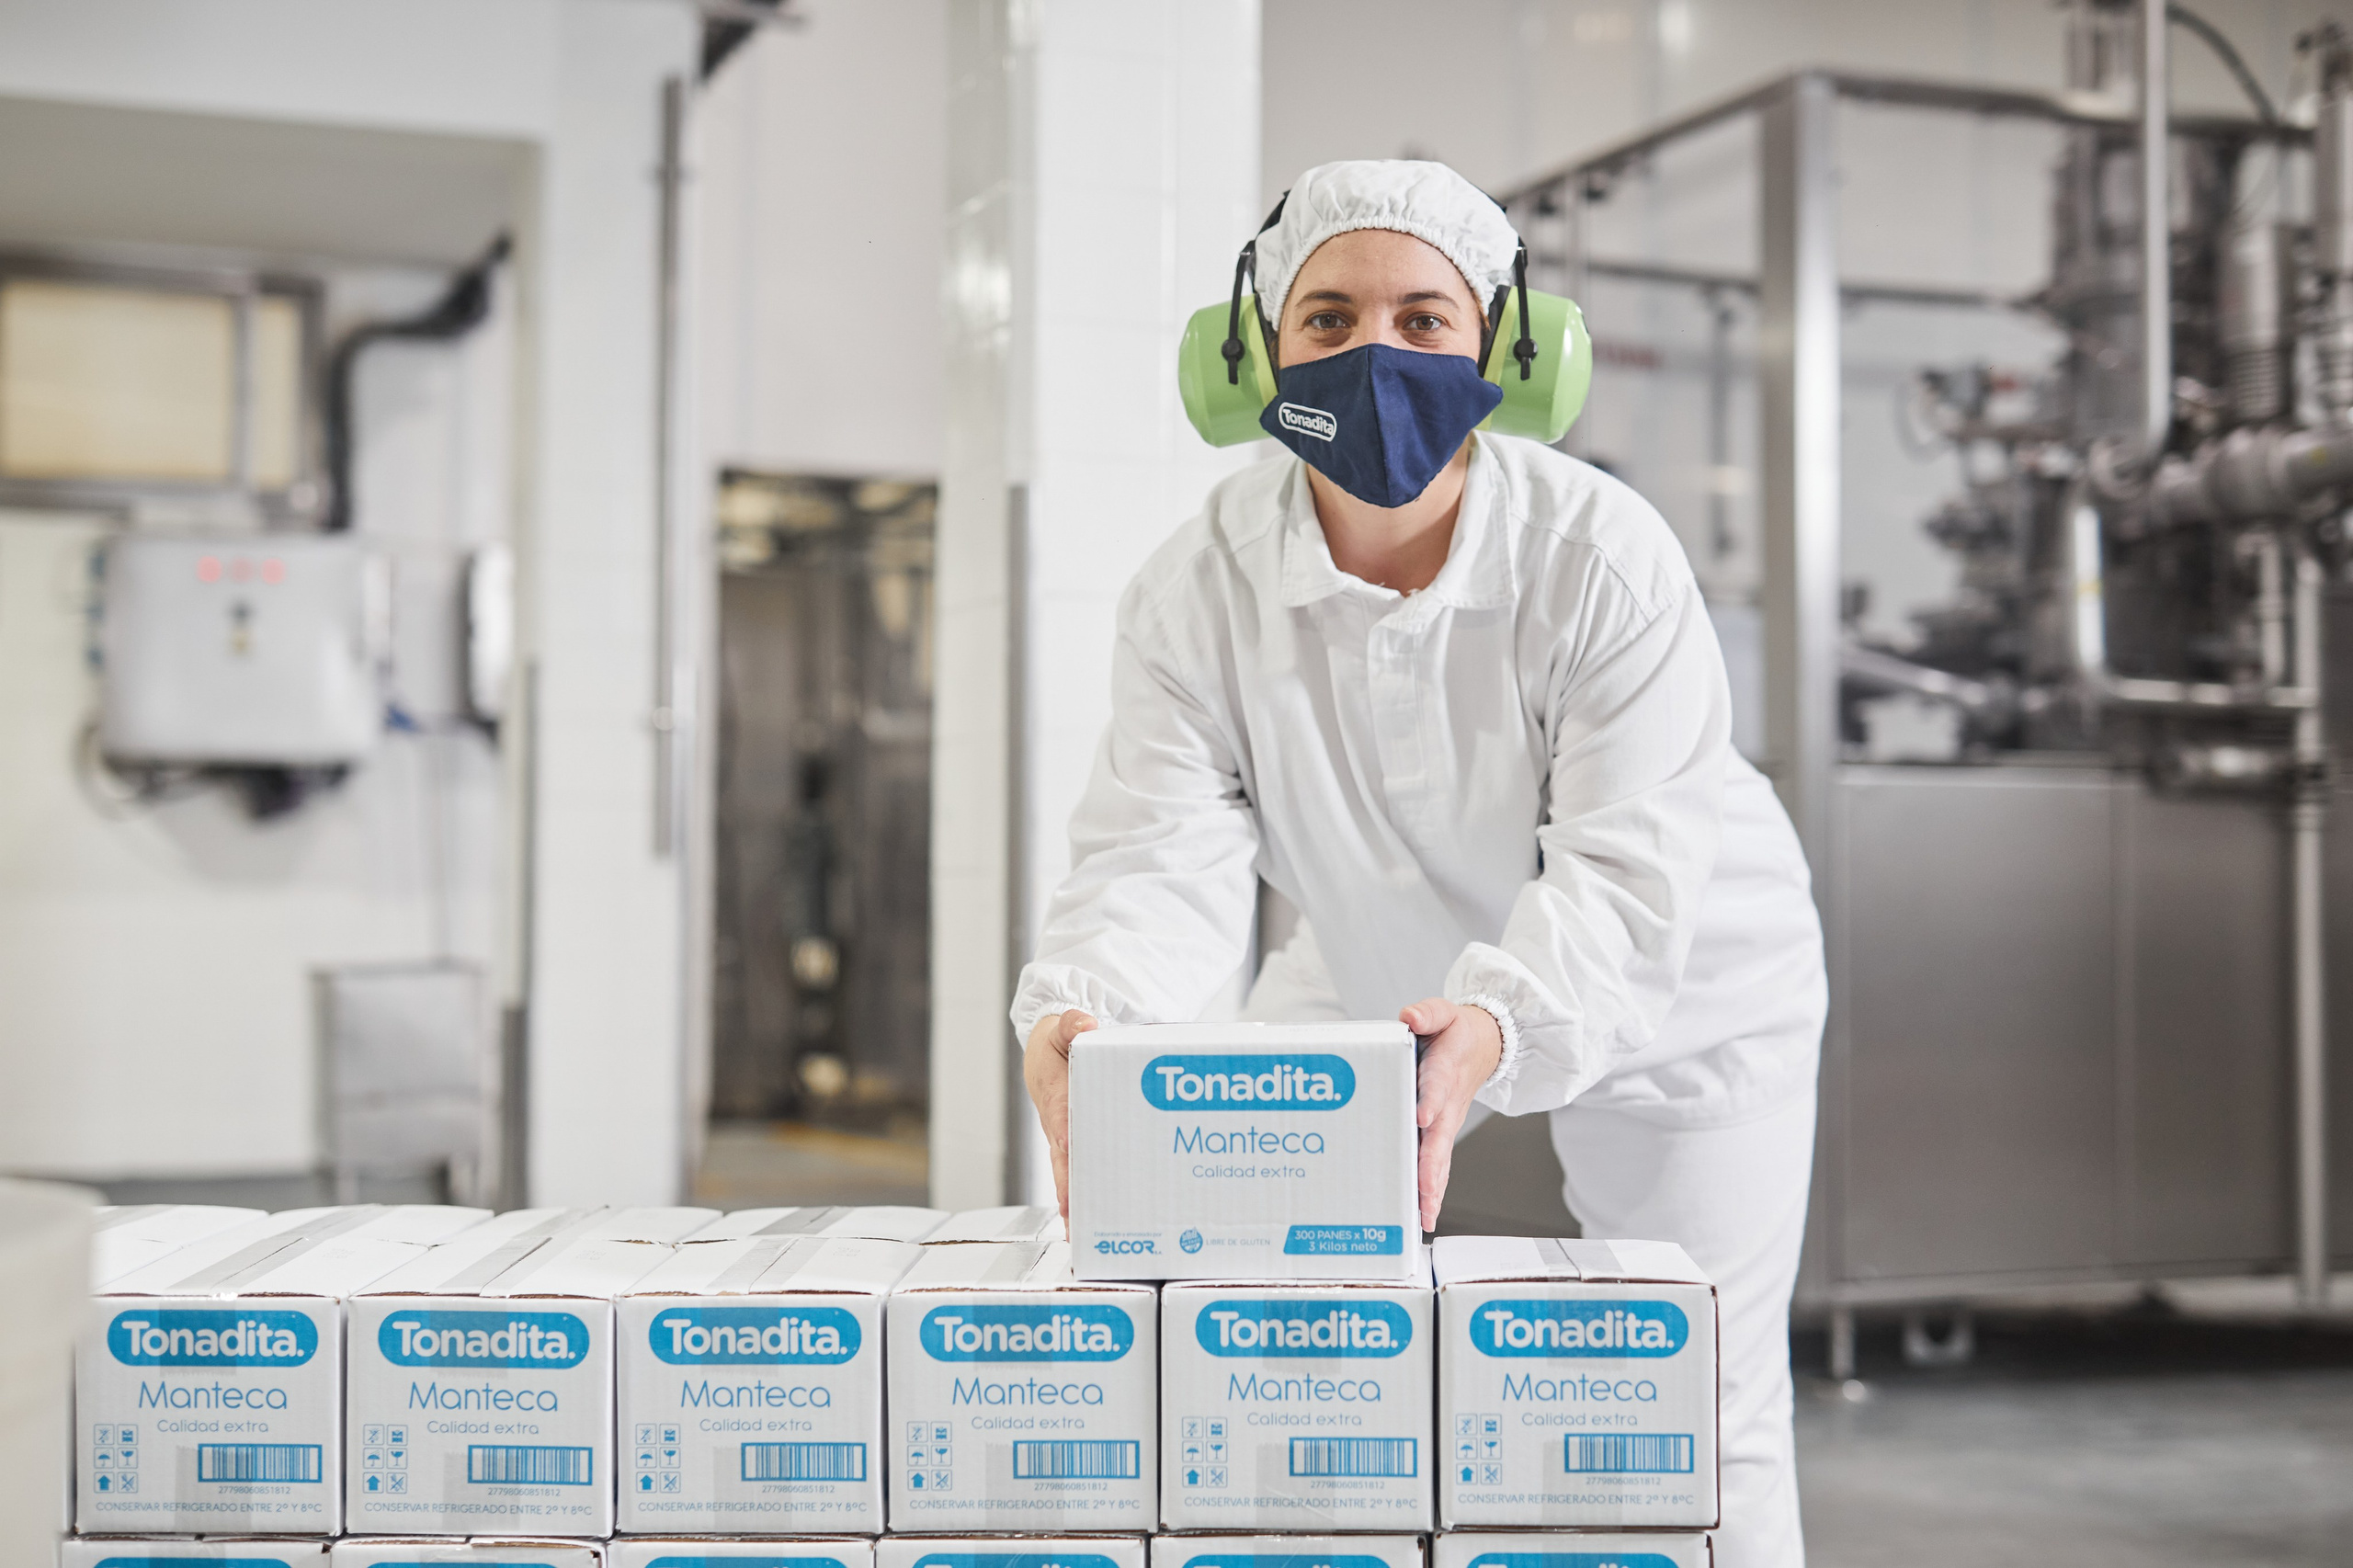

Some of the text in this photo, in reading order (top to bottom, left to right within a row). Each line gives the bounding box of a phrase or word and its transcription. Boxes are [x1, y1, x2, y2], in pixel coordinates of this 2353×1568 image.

[1283, 409, 1334, 436] Tonadita
[1174, 1126, 1324, 1154] Manteca
[1191, 1165, 1305, 1178] Calidad extra
[1295, 1231, 1314, 1240] 300
[1318, 1231, 1351, 1240] PANES
[1362, 1228, 1386, 1242] 10g
[1309, 1241, 1377, 1252] 3 Kilos neto
[952, 1377, 1103, 1405] Manteca
[1228, 1373, 1381, 1402] Manteca
[1502, 1373, 1656, 1401] Manteca
[139, 1381, 287, 1409] Manteca
[409, 1381, 557, 1412] Manteca
[681, 1381, 830, 1407] Manteca
[157, 1419, 268, 1432] Calidad extra
[699, 1419, 813, 1432] Calidad extra
[972, 1416, 1085, 1429] Calidad extra
[1247, 1412, 1361, 1426] Calidad extra
[1521, 1413, 1638, 1426] Calidad extra
[426, 1421, 539, 1435] Calidad extra
[910, 1500, 974, 1509] CONSERVAR
[979, 1500, 1053, 1509] REFRIGERADO
[1057, 1500, 1088, 1509] ENTRE
[1109, 1500, 1115, 1509] Y
[1184, 1497, 1250, 1506] CONSERVAR
[1254, 1498, 1330, 1507] REFRIGERADO
[1333, 1498, 1366, 1507] ENTRE
[1386, 1499, 1393, 1508] Y
[1458, 1494, 1524, 1504] CONSERVAR
[1528, 1494, 1606, 1504] REFRIGERADO
[1608, 1494, 1642, 1505] ENTRE
[1663, 1494, 1669, 1505] Y
[96, 1502, 160, 1511] CONSERVAR
[164, 1503, 237, 1512] REFRIGERADO
[241, 1504, 272, 1513] ENTRE
[292, 1505, 298, 1513] Y
[365, 1502, 428, 1512] CONSERVAR
[432, 1504, 507, 1513] REFRIGERADO
[509, 1506, 542, 1515] ENTRE
[561, 1506, 567, 1515] Y
[638, 1502, 702, 1511] CONSERVAR
[706, 1503, 781, 1511] REFRIGERADO
